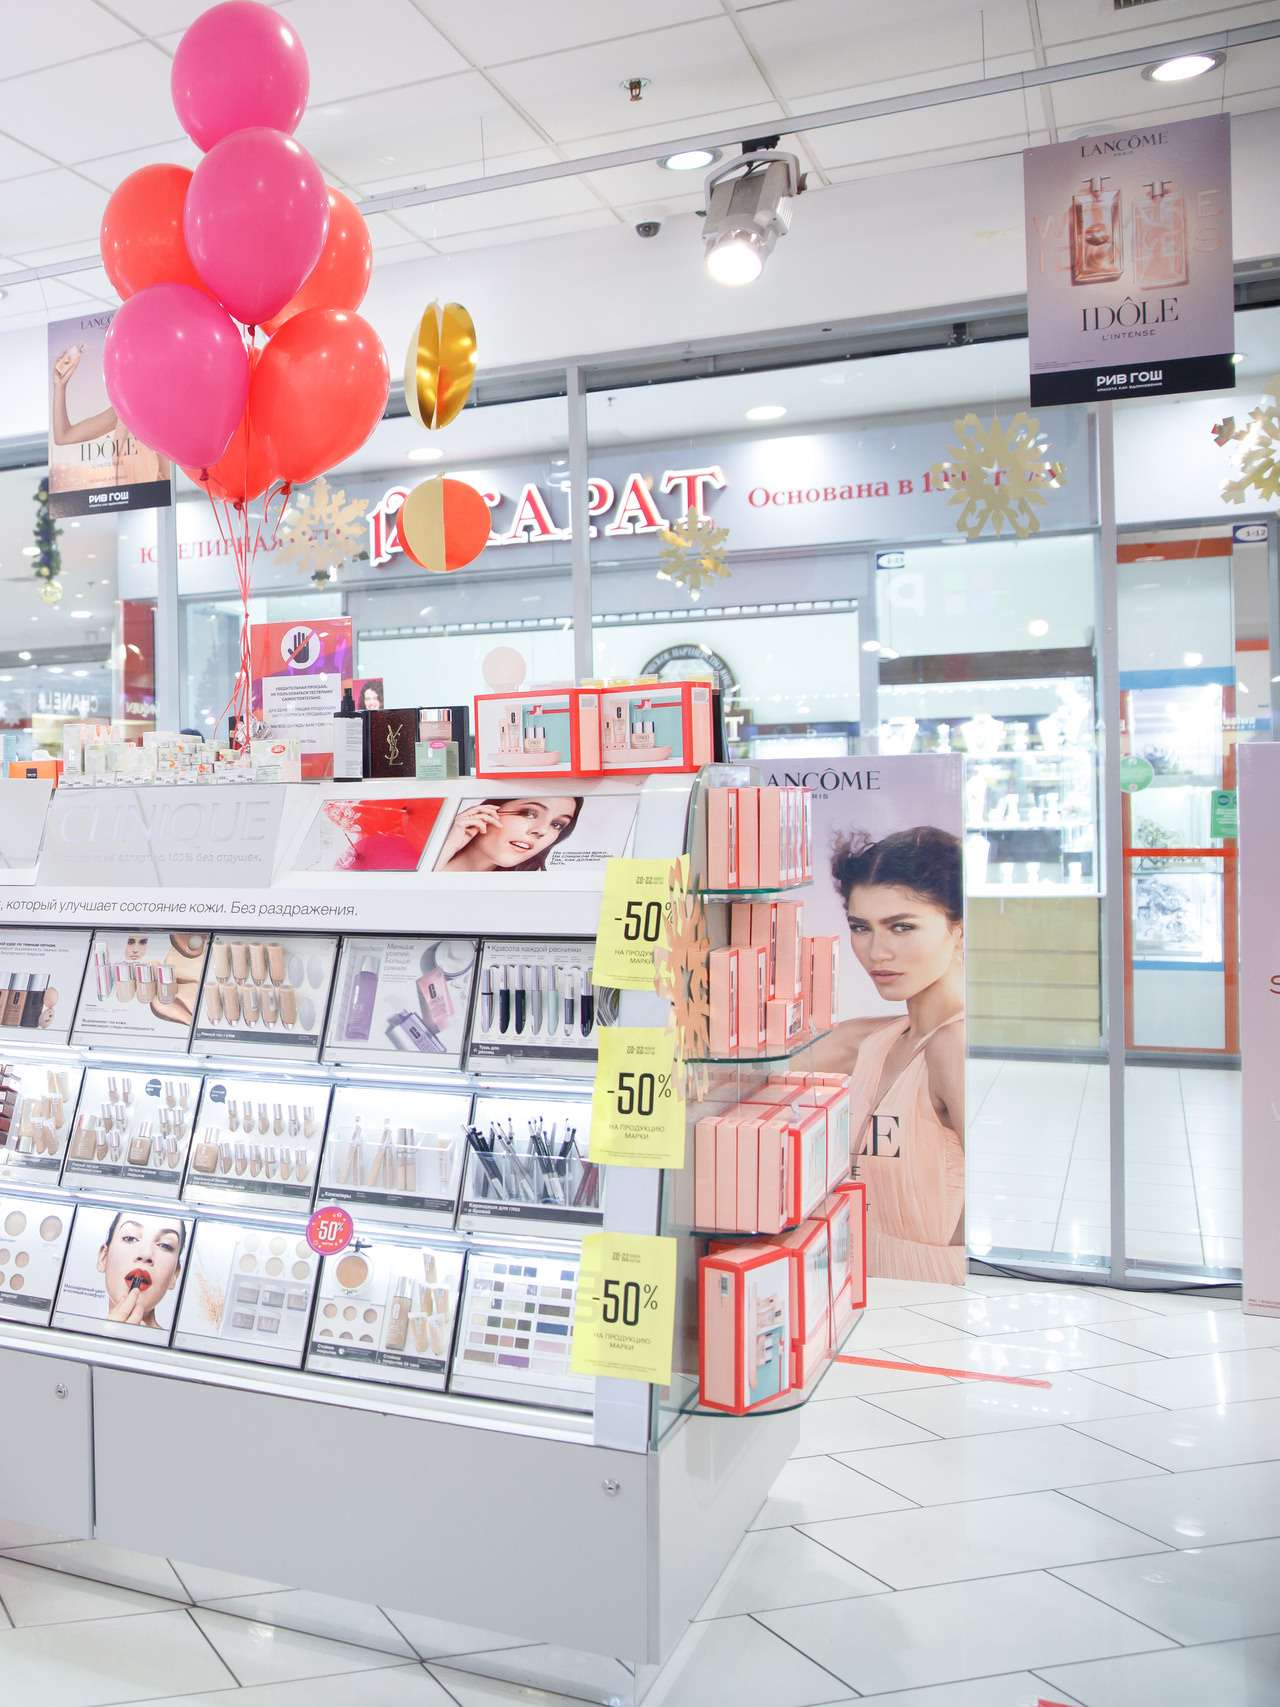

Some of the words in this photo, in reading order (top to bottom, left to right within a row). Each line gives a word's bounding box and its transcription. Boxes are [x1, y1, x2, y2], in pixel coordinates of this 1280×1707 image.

[1080, 131, 1168, 158] LANCÔME
[1080, 296, 1179, 332] IDÔLE
[1096, 373, 1128, 387] РИВ
[1130, 369, 1164, 384] ГОШ
[81, 435, 138, 462] IDÔLE
[88, 493, 108, 504] РИВ
[109, 491, 129, 501] ГОШ
[768, 767, 880, 790] ANCÔME
[6, 897, 58, 913] который
[58, 900, 118, 914] улучшает
[119, 901, 186, 913] состояние
[189, 902, 228, 914] кожи.
[231, 900, 256, 915] Без
[258, 902, 359, 919] раздражения.
[491, 944, 520, 953] Красота
[521, 945, 548, 954] каждой
[607, 1071, 672, 1116] -50%
[620, 1124, 665, 1133] ПРОДУКЦИЮ
[624, 1132, 650, 1140] МАРКИ
[592, 1279, 659, 1326] -50%
[605, 1332, 651, 1346] ПРОДУКЦИЮ
[609, 1342, 635, 1351] МАРКИ
